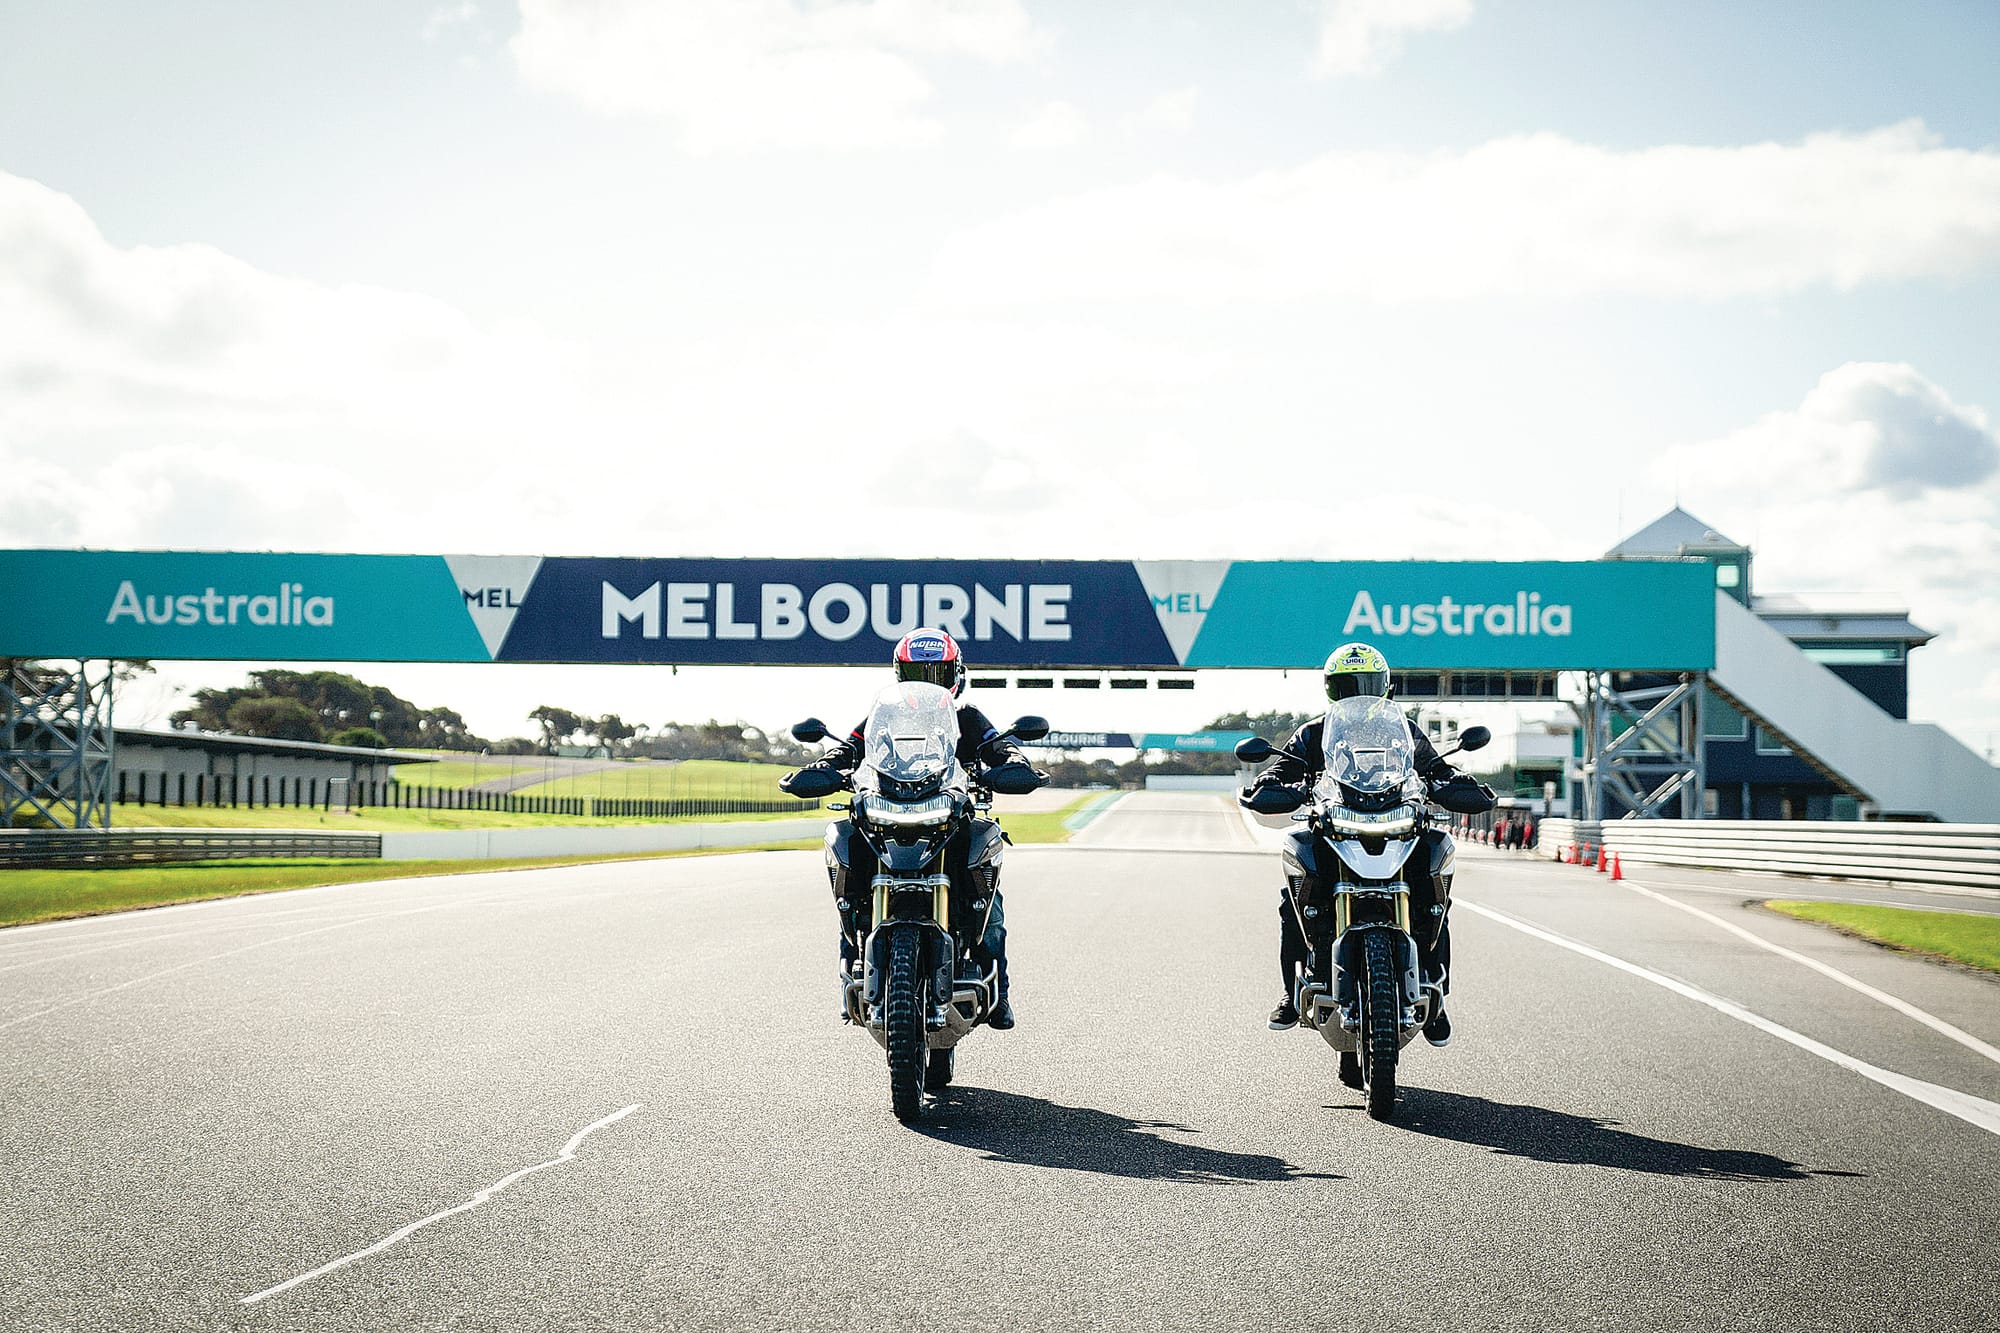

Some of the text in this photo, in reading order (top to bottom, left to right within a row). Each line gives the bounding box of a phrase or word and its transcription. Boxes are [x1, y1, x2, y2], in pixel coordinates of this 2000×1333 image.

[106, 580, 333, 626] Australia
[463, 587, 521, 608] MEL
[602, 580, 1072, 641] MELBOURNE
[1152, 591, 1208, 613] MEL
[1342, 590, 1572, 636] Australia
[909, 640, 946, 651] NOLAN
